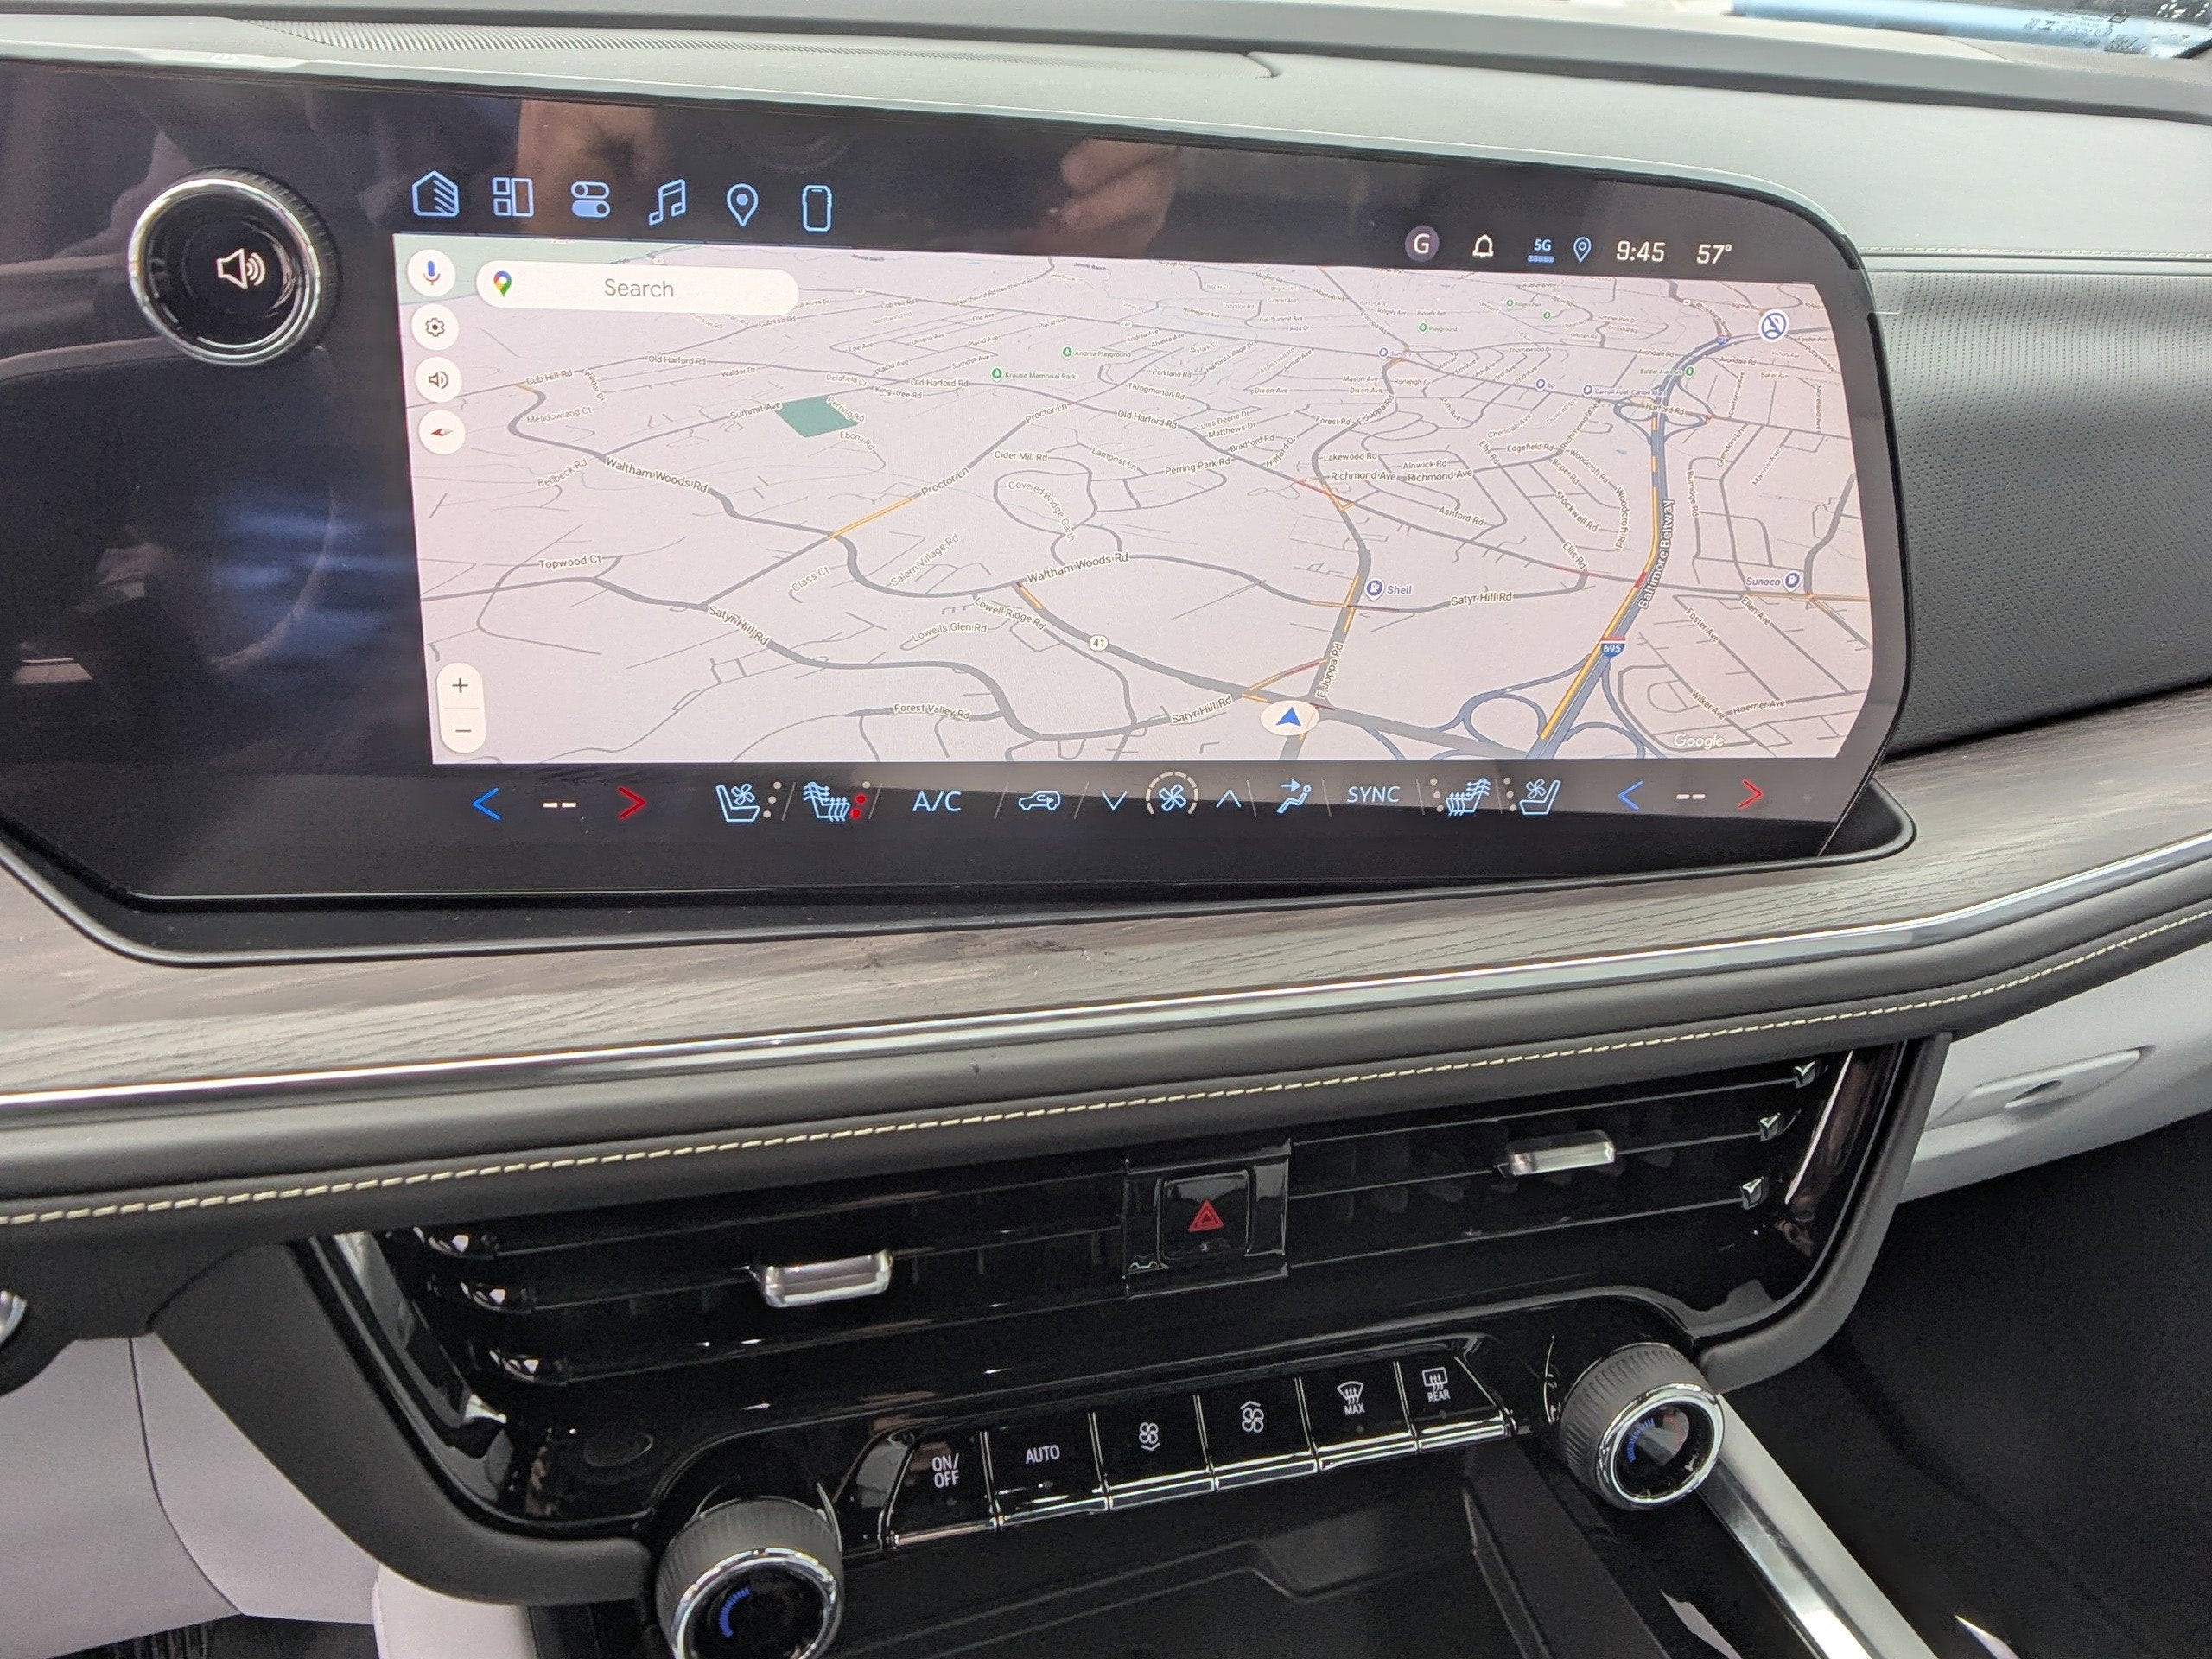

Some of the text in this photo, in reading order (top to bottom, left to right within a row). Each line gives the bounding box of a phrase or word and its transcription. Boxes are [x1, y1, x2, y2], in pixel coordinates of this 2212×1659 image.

[1414, 233, 1430, 254] G
[1533, 238, 1552, 251] 5G
[1616, 240, 1666, 263] 9:45
[1696, 244, 1733, 264] 57°
[604, 278, 675, 298] Search
[648, 354, 707, 366] Old Harford Rd
[951, 354, 990, 370] Summit Ave
[1098, 351, 1131, 360] Playground
[875, 359, 909, 374] Placid Ave
[1153, 369, 1179, 378] Parkland
[875, 386, 911, 397] Kingstree
[925, 379, 955, 388] Harford
[957, 380, 969, 389] Rd
[1128, 383, 1185, 400] Throgmorton Rd
[730, 401, 782, 420] Summit Ave
[827, 396, 865, 423] Perring Rd
[1026, 403, 1068, 423] Proctor Ln
[1365, 405, 1385, 422] Joppa
[1383, 395, 1395, 407] Rd
[1441, 398, 1461, 422] 5th Ave
[1546, 398, 1577, 425] Duncan Ln
[1644, 404, 1670, 413] Harford
[1118, 411, 1178, 429] Old Harford Rd
[1560, 403, 1599, 450] Richmond Ave
[840, 431, 876, 451] Ebony Rd
[1209, 426, 1246, 438] Matthews
[1287, 435, 1296, 445] Dr
[1230, 437, 1262, 452] Bradford
[1478, 440, 1500, 465] Ellis Rd
[1507, 443, 1554, 453] Edgefield Rd
[995, 451, 1017, 460] Cider
[1036, 453, 1047, 461] Rd
[1092, 447, 1137, 471] Lampost Ln
[1166, 457, 1230, 474] Perring Park Rd
[1402, 461, 1434, 469] Alnwick
[537, 458, 588, 487] Bellbeck Rd
[606, 457, 709, 493] Waltham Woods Rd
[1331, 471, 1377, 480] Richmond
[1408, 469, 1472, 481] Richmond Ave
[1552, 458, 1580, 486] Roper Rd
[1570, 449, 1610, 484] Woodcroft Rd
[921, 467, 969, 497] Proctor Ln
[1008, 481, 1075, 542] Covered Bridge Garth
[1439, 506, 1484, 526] Ashford Rd
[1554, 490, 1599, 533] Stockwell Rd
[1616, 487, 1630, 549] Woodcroft Rd
[539, 555, 602, 569] Topwood Ct
[890, 533, 960, 587] Salem Village Rd
[1562, 542, 1587, 569] Ellis Rd
[1638, 499, 1675, 608] Baltimore Beltway
[1027, 553, 1128, 583] Waltham Woods Rd
[791, 566, 830, 593] Class Ct
[1387, 585, 1412, 594] Shell
[1746, 577, 1781, 587] Sunoco
[1451, 592, 1513, 607] Satyr Hill Rd
[974, 596, 1046, 631] Lowell Ridge Rd
[1741, 596, 1770, 626] Ellen Ave
[709, 606, 769, 645] Satyr Hill Rd
[912, 623, 987, 642] Lowells Glen Rd
[1686, 607, 1719, 643] Foster Ave
[1093, 639, 1104, 648] 41
[1603, 644, 1622, 653] 695
[1317, 643, 1343, 697] E Joppa Rd
[894, 703, 970, 721] Forest Valley Rd
[1171, 695, 1232, 724] Satyr Hill Rd
[1691, 690, 1726, 721] Wilker Ave
[1674, 733, 1725, 750] Google
[912, 791, 963, 813] A/C
[1347, 785, 1401, 804] SYNC
[1427, 1389, 1450, 1402] REAR
[1344, 1402, 1365, 1415] MAX
[931, 1453, 959, 1471] ON/
[1025, 1444, 1060, 1465] AUTO
[933, 1470, 960, 1489] OFF
